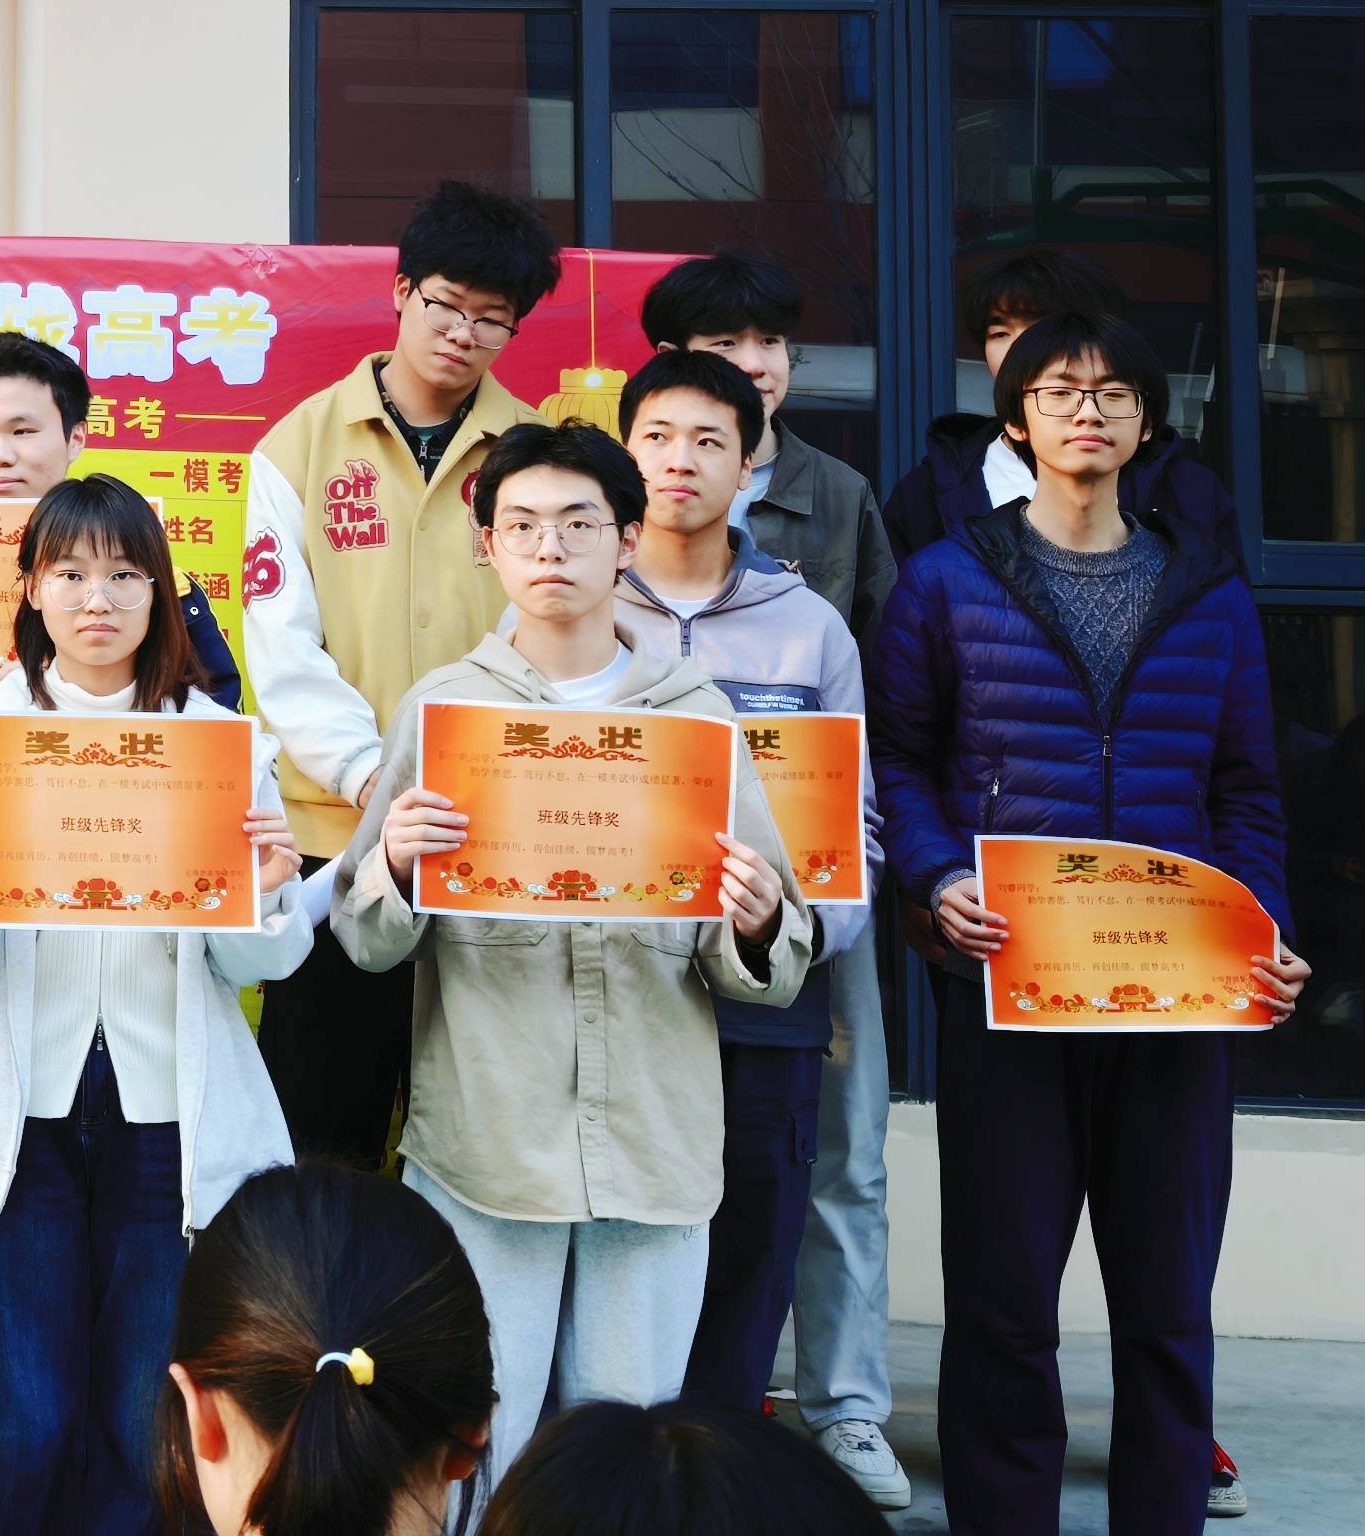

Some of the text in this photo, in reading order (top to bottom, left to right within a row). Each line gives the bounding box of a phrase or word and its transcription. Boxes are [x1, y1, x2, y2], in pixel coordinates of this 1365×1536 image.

[149, 458, 244, 494] 一模考
[328, 467, 377, 500] Off
[328, 502, 377, 525] The
[164, 516, 213, 545] 姓名
[327, 523, 386, 550] Wall
[61, 816, 143, 834] 班级先锋奖
[537, 809, 620, 827] 班级先锋奖
[1092, 930, 1168, 945] 班级先锋奖
